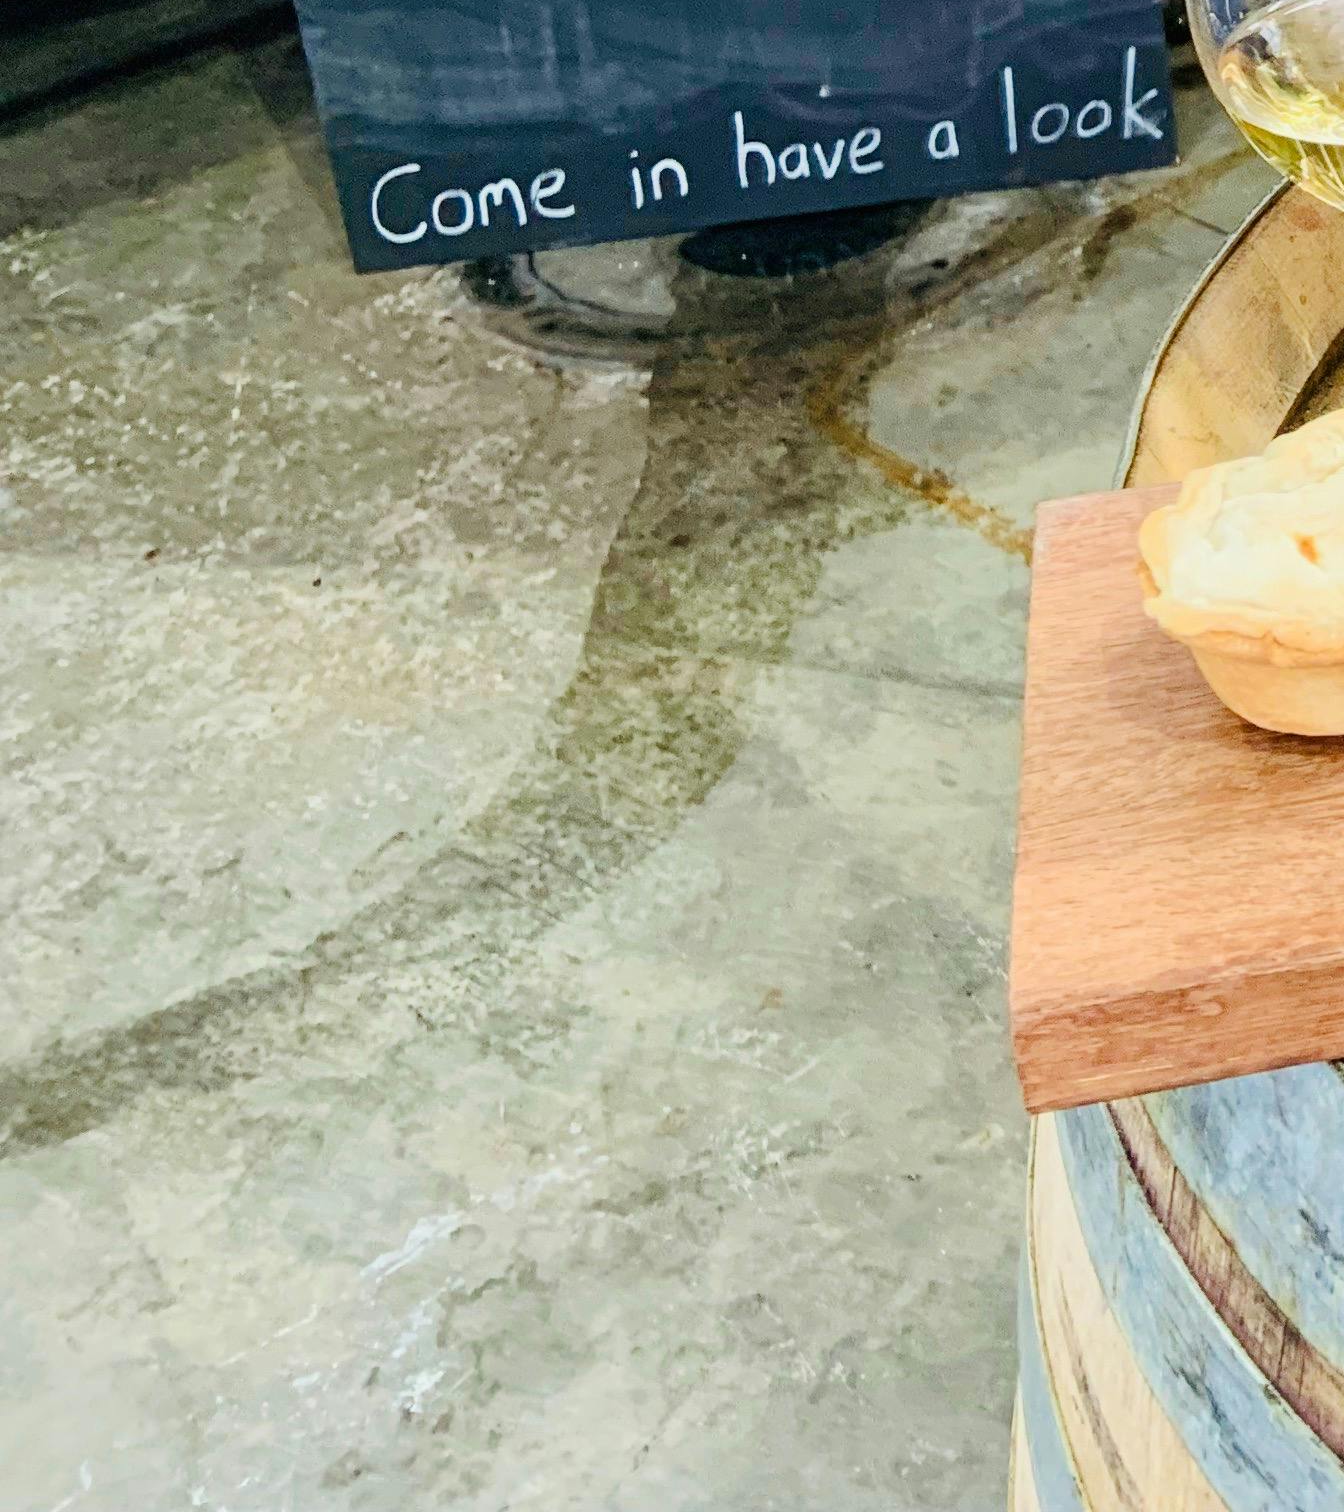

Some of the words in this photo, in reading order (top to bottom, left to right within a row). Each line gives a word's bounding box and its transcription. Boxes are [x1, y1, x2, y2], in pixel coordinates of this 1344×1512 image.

[369, 161, 577, 245] Come
[628, 150, 691, 212] in
[733, 84, 886, 191] have
[926, 118, 963, 161] a
[1002, 45, 1167, 156] look
